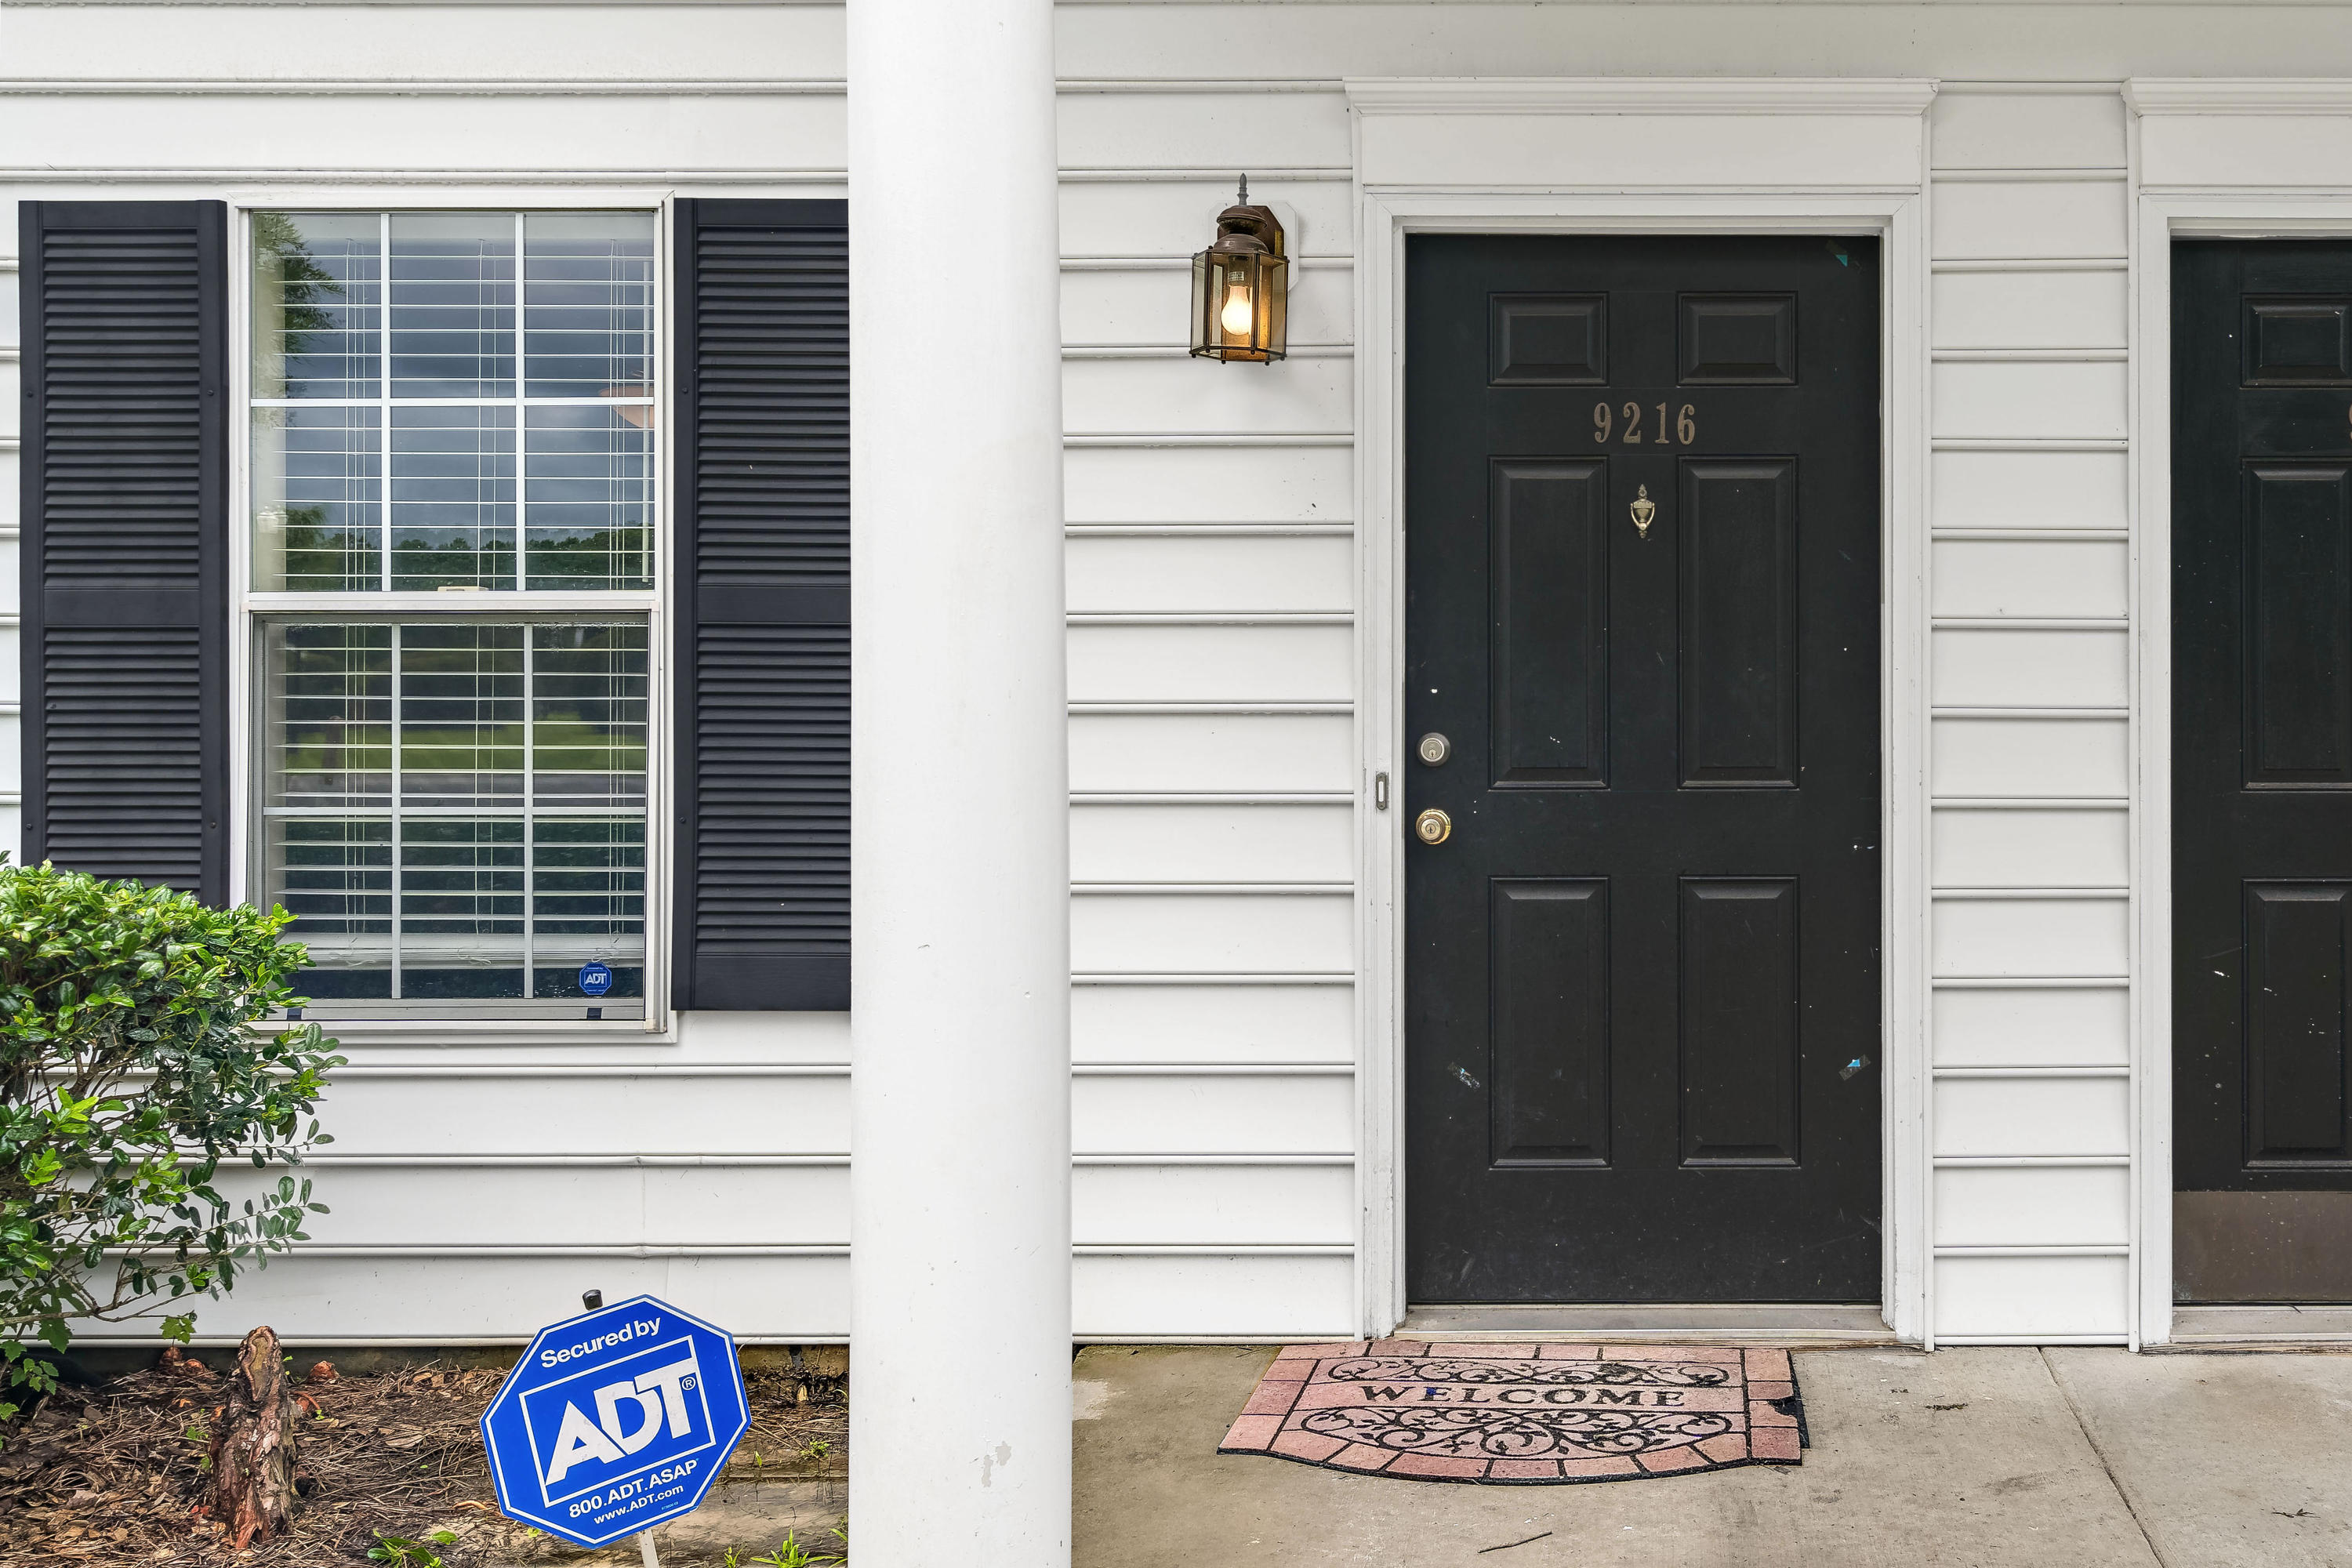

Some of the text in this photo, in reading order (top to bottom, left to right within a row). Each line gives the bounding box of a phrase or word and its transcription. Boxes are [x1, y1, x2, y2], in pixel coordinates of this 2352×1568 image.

[1594, 401, 1695, 445] 9216
[585, 973, 607, 984] ADT
[540, 1317, 662, 1368] Secured by
[1361, 1386, 1685, 1407] WELCOME
[546, 1357, 699, 1485] ADT
[593, 1485, 684, 1524] www.ADT.com
